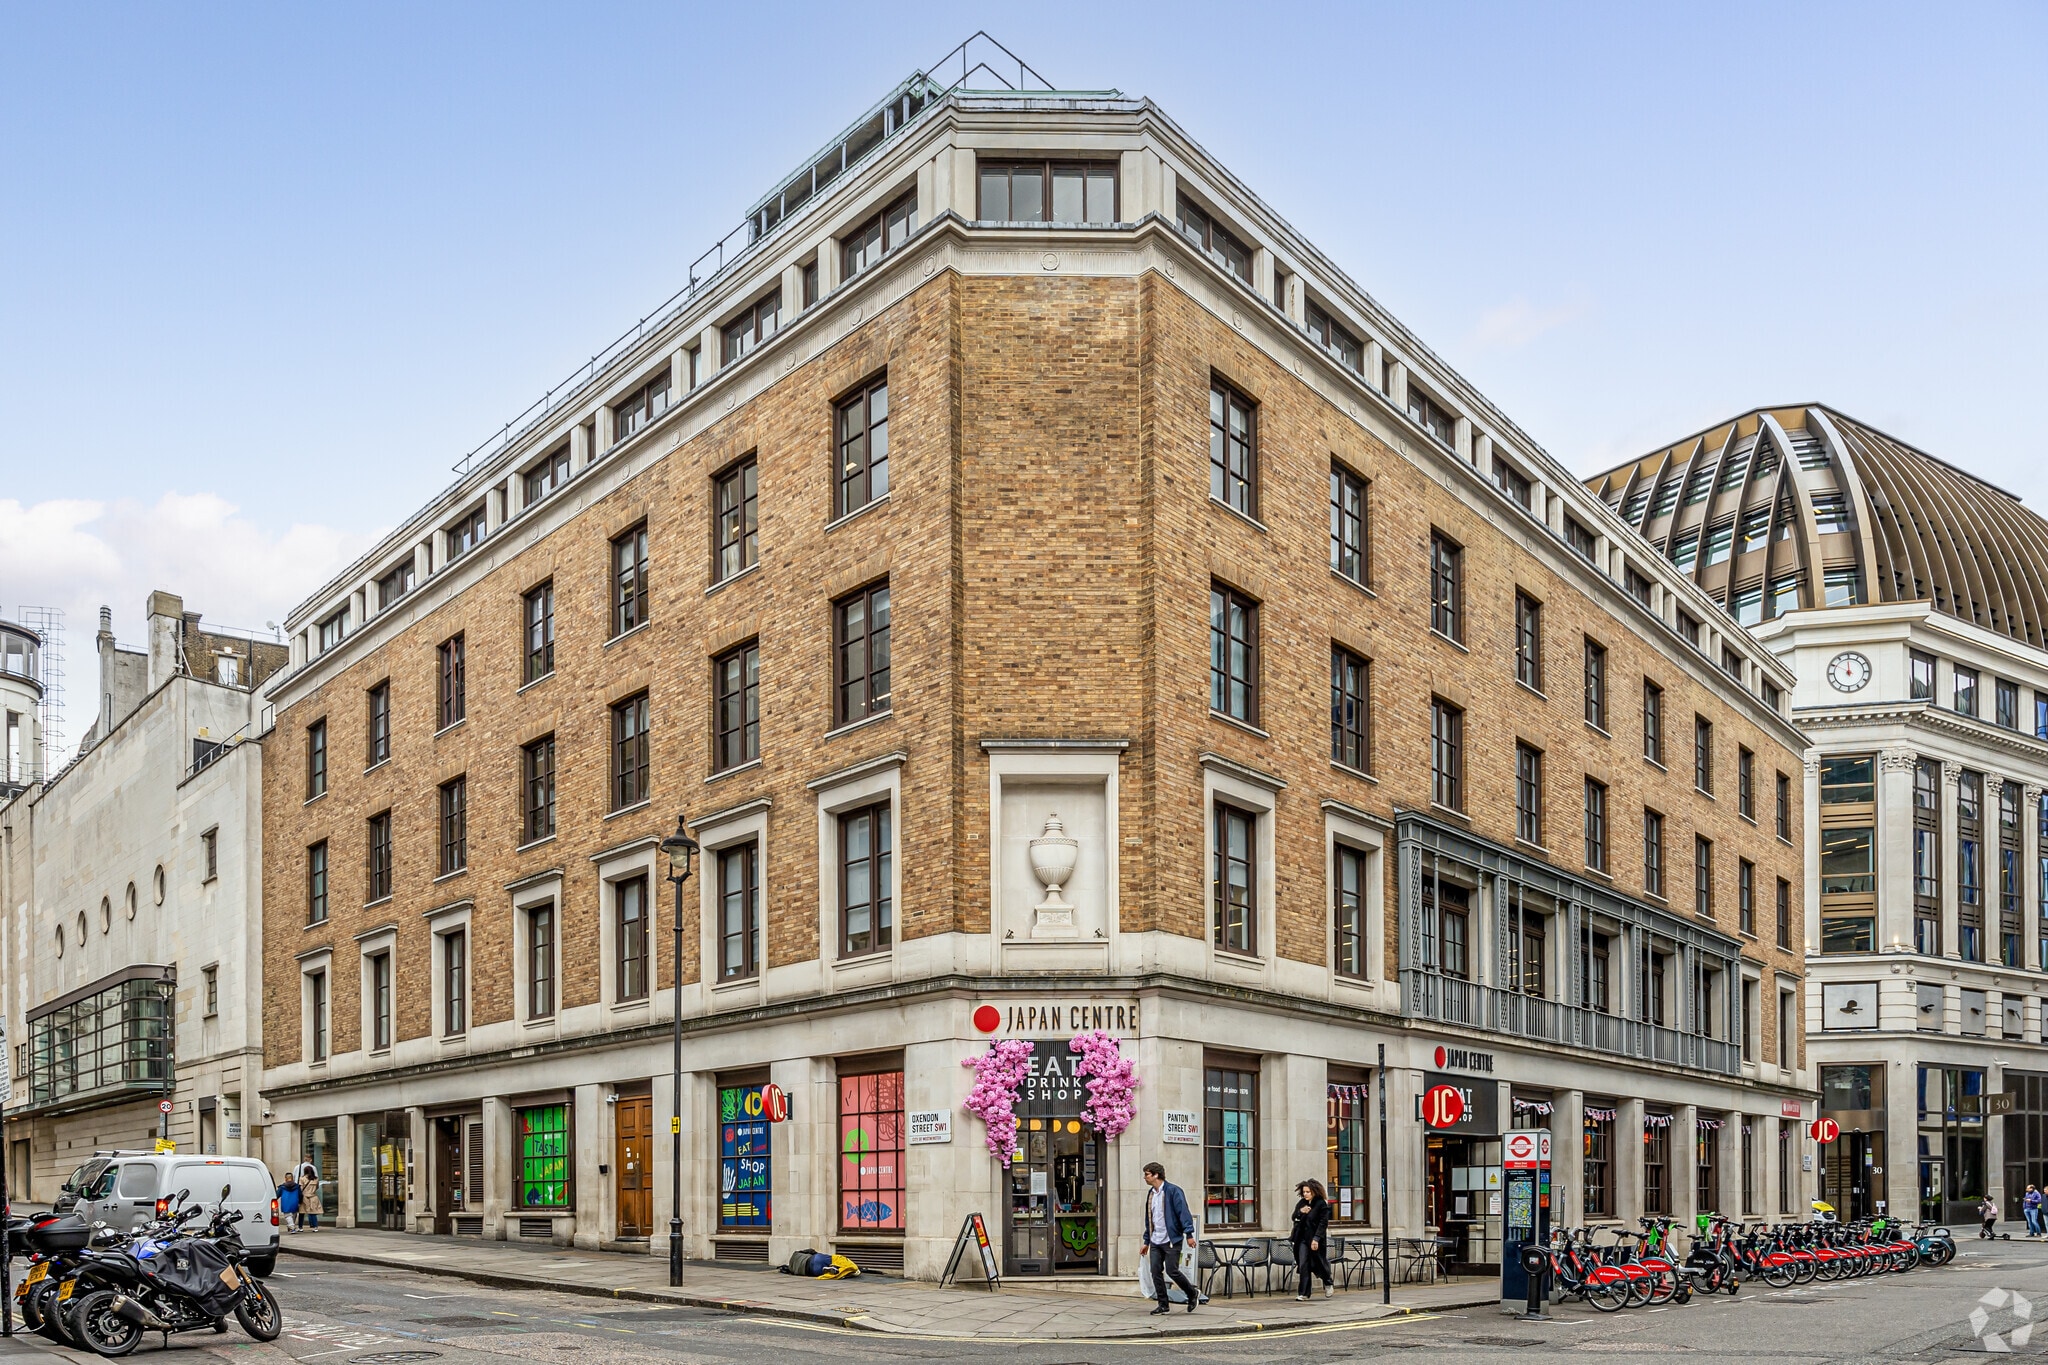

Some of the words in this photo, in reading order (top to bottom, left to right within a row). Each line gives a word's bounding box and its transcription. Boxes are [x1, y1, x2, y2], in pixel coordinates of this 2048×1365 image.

[1007, 1006, 1061, 1032] JAPAN
[1070, 1005, 1137, 1030] CENTRE
[1027, 1056, 1082, 1076] EAT
[1447, 1048, 1467, 1069] JAPAN
[1469, 1052, 1494, 1072] CENTRE
[1027, 1078, 1082, 1088] DRINK
[1027, 1090, 1082, 1100] SHOP
[1456, 1087, 1472, 1104] AT
[1431, 1088, 1454, 1127] JC
[1995, 1099, 2010, 1110] 30
[912, 1113, 938, 1123] OXENDON
[1168, 1113, 1188, 1122] PANTON
[912, 1124, 933, 1133] STREET
[934, 1123, 947, 1131] SW1
[1168, 1124, 1186, 1132] STREET
[1188, 1124, 1198, 1133] SW1
[1817, 1120, 1832, 1142] JC
[738, 1141, 751, 1155] EAT
[741, 1158, 764, 1174] SHOP
